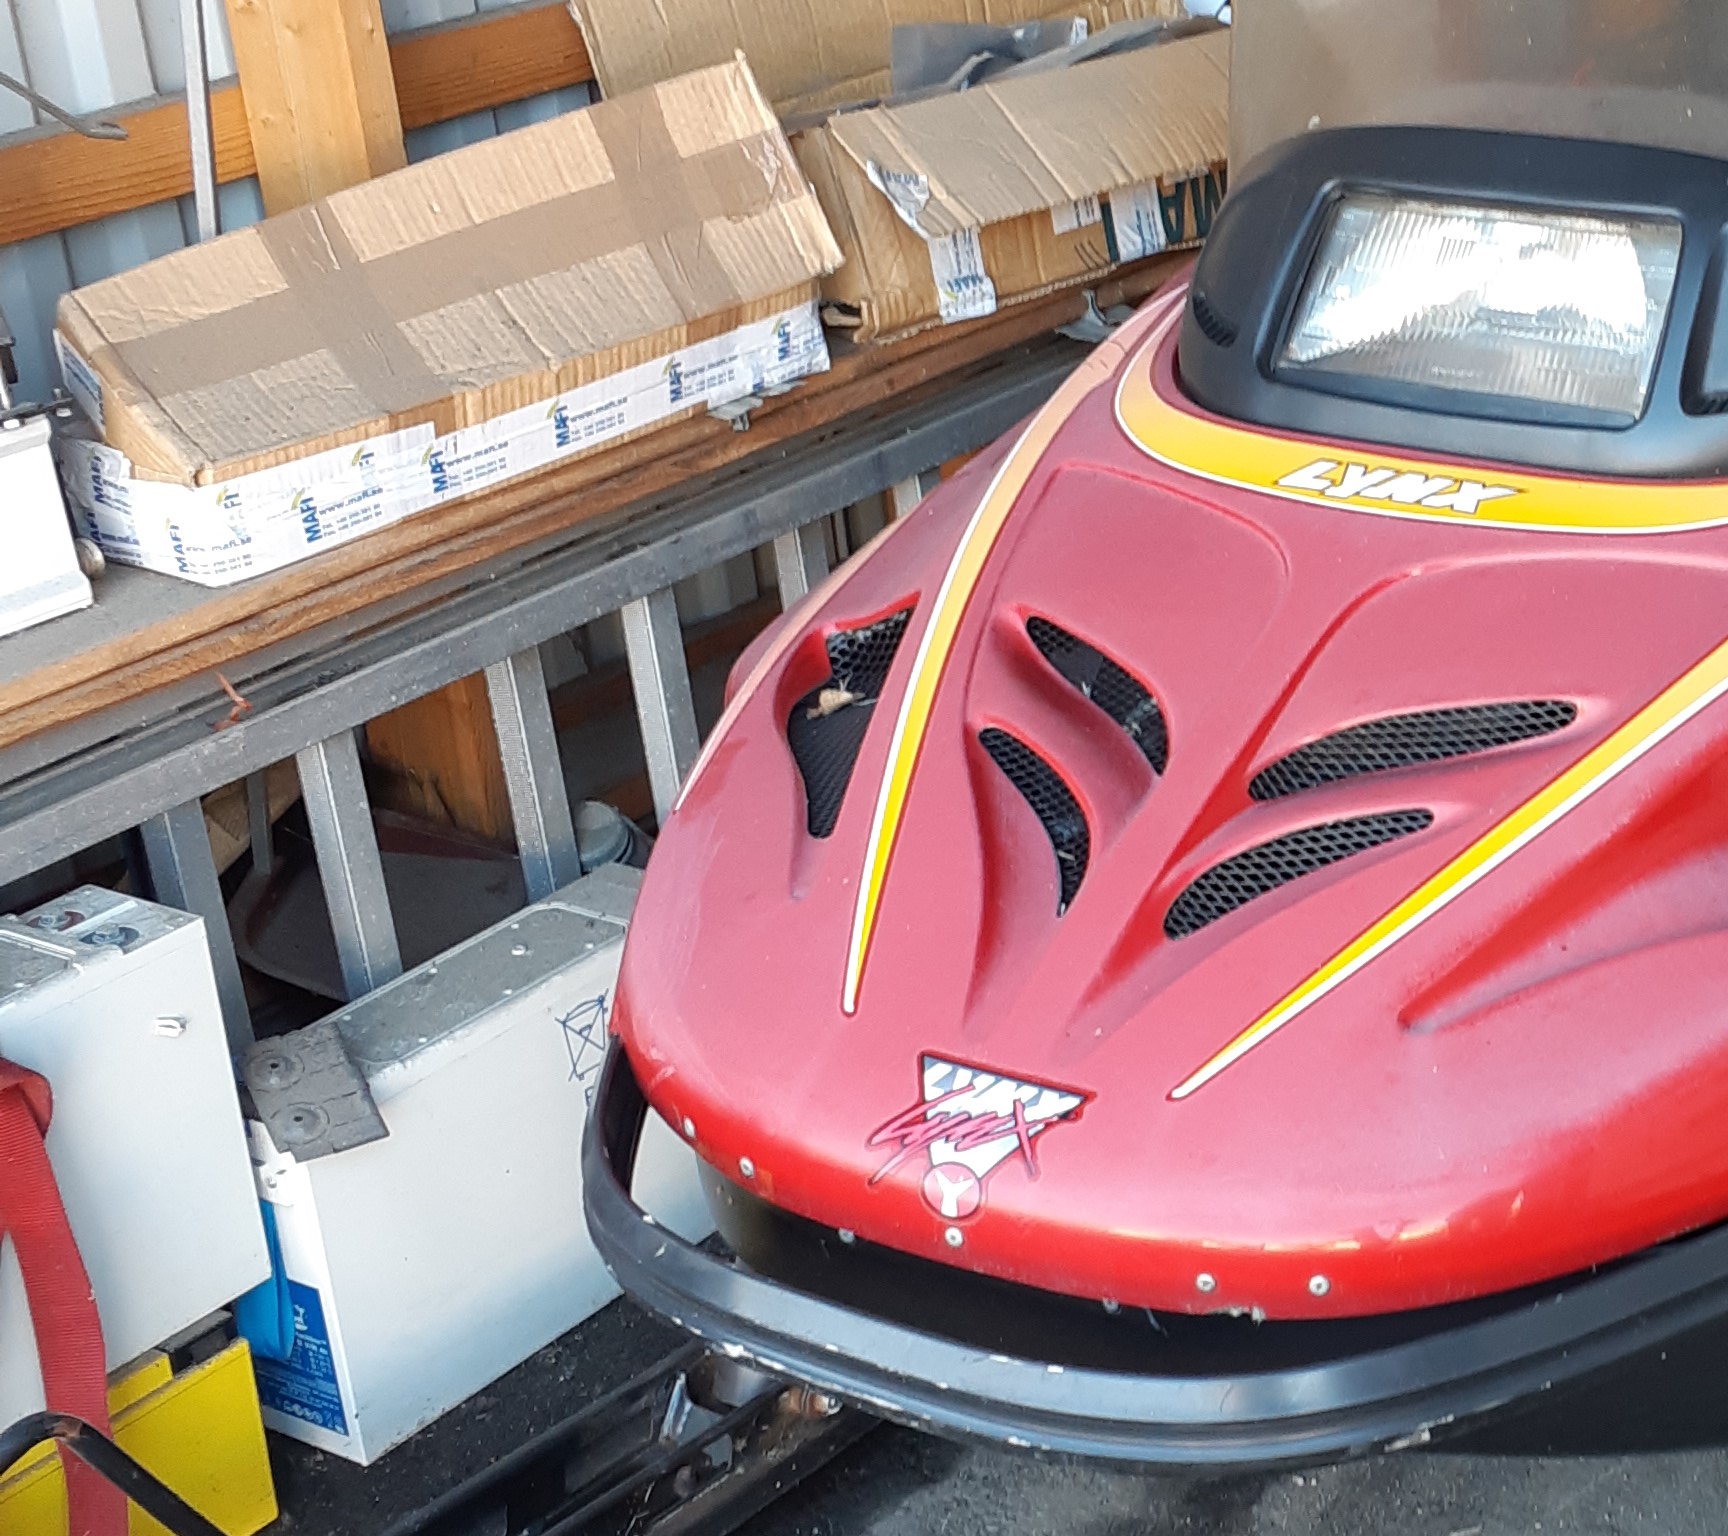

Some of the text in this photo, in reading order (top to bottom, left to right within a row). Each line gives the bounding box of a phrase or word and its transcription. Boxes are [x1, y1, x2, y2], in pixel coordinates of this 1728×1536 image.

[1101, 162, 1228, 261] MAI
[555, 405, 571, 448] MAFI
[91, 455, 104, 505] MAFI
[429, 450, 449, 493] MAFI
[1273, 458, 1527, 514] LYNX
[87, 511, 102, 543] AFI
[300, 496, 323, 544] MAFI
[169, 524, 190, 574] MAFI
